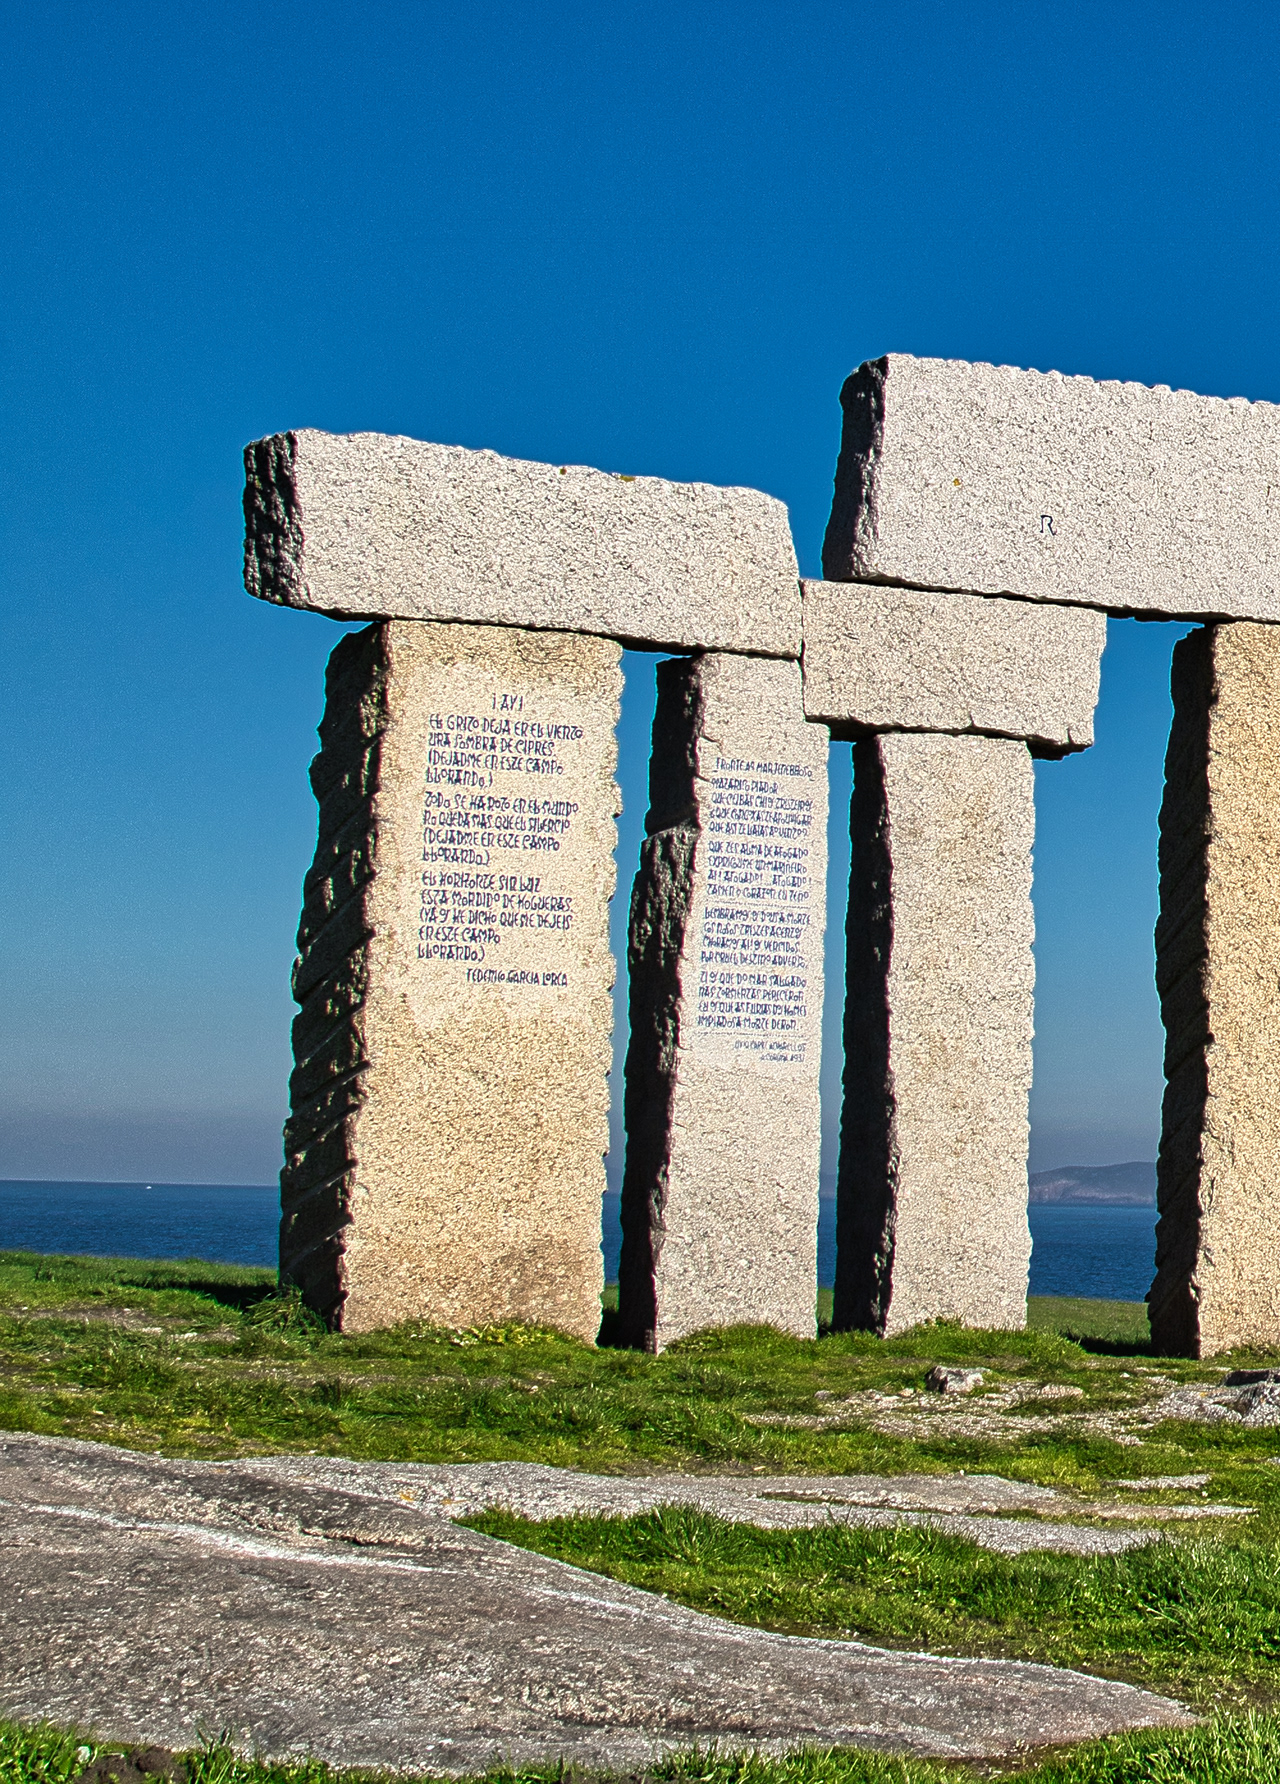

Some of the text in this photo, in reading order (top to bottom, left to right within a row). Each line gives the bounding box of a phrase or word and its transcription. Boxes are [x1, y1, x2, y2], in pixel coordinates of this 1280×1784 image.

[430, 714, 583, 740] EL GRITO DEJA EN EL VIENTO
[429, 732, 450, 747] UNA
[454, 734, 497, 752] SOMBRA
[500, 738, 513, 753] DE
[485, 754, 498, 770] EN
[500, 756, 523, 771] ESTE
[526, 757, 564, 775] CAMPO
[425, 791, 578, 817] TODO SE HA ROTO EN EL MUNDO
[423, 810, 436, 826] NO
[439, 811, 470, 827] QUEDA
[495, 815, 513, 830] QUE
[515, 817, 526, 831] EL
[528, 817, 570, 834] SILENCIO
[481, 832, 495, 847] EN
[497, 833, 519, 849] ESTE
[522, 834, 560, 851] CAMPO
[422, 871, 541, 893] EL HORIZONTE SIN LUZ
[452, 891, 499, 908] MORDIDO
[502, 893, 516, 909] DE
[452, 908, 465, 924] HE
[468, 909, 497, 925] DICHO
[500, 911, 518, 928] QUE
[520, 912, 534, 928] ME
[419, 925, 501, 944] EN ESTE CAMPO
[542, 971, 568, 987] LORCA
